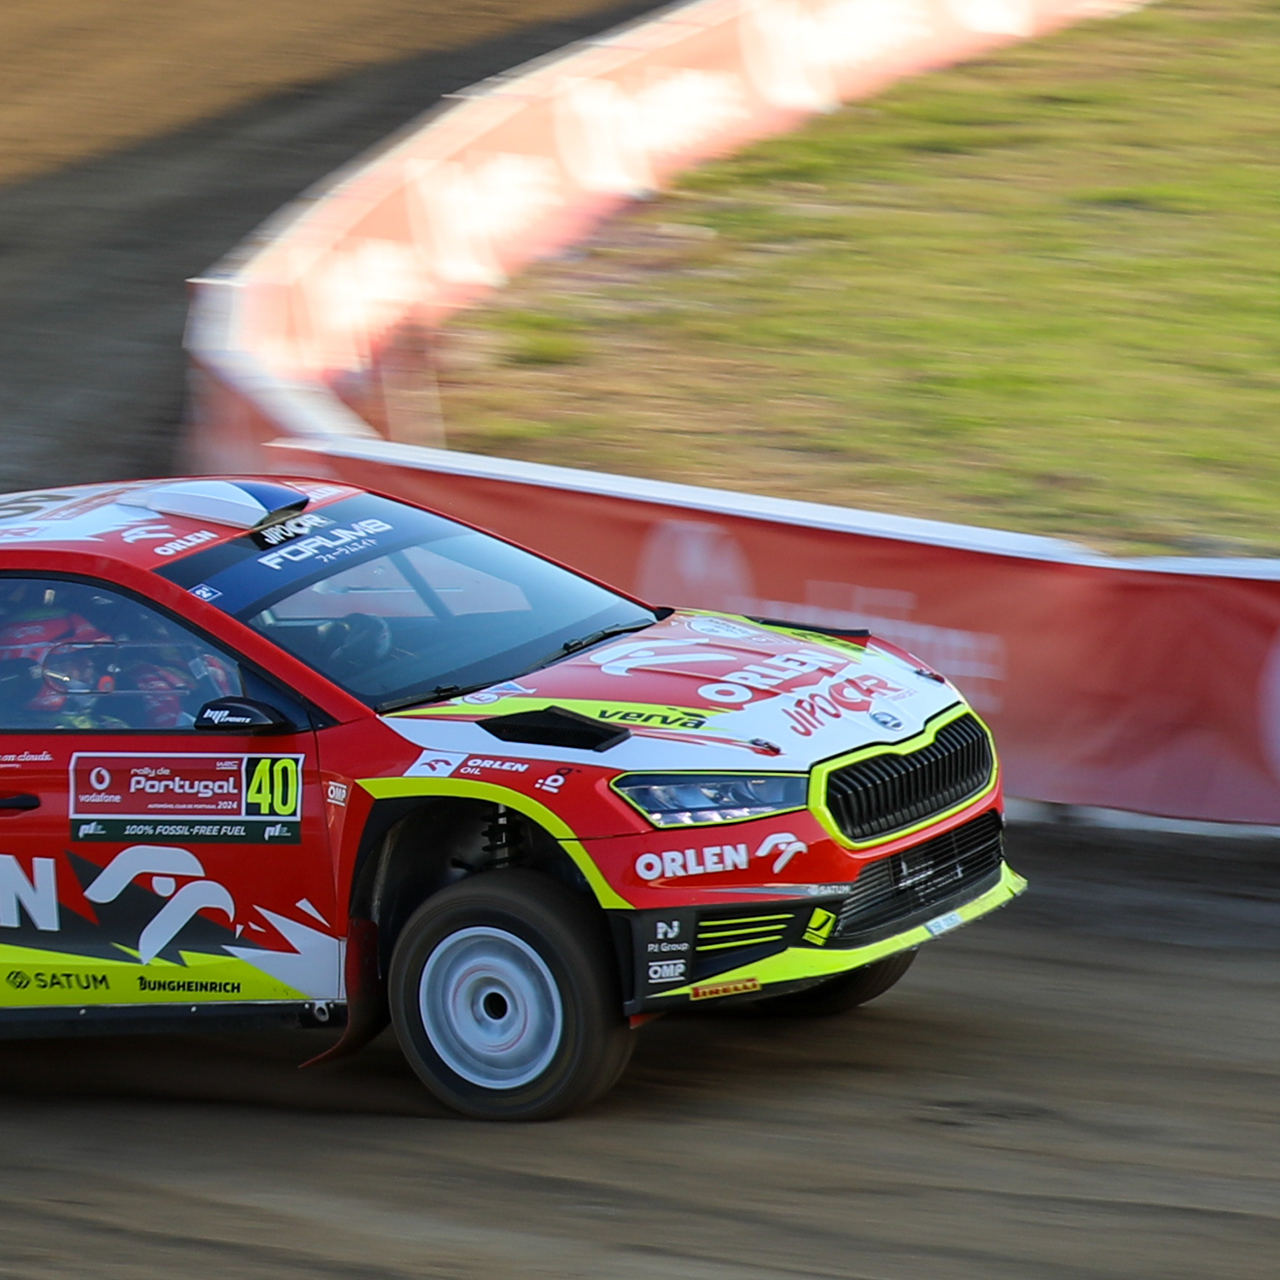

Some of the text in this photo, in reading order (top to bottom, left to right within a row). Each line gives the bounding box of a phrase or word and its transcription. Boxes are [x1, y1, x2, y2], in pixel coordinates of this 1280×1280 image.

[153, 530, 219, 556] ORLEN
[697, 649, 848, 703] ORLEN
[597, 707, 707, 730] verva
[130, 767, 171, 777] rally de
[459, 766, 482, 776] OIL
[467, 758, 529, 773] ORLEN
[129, 777, 239, 798] Portugal
[246, 758, 298, 816] 40
[327, 784, 348, 802] OMP
[78, 792, 122, 803] vodafone
[217, 801, 238, 809] 2024
[124, 824, 246, 837] 100% FOSSIL-FREE FUEL
[635, 843, 750, 881] ORLEN
[660, 942, 690, 952] Group
[648, 963, 687, 979] OMP
[34, 972, 110, 991] SATUM
[138, 975, 242, 993] JUNGHEINRICH
